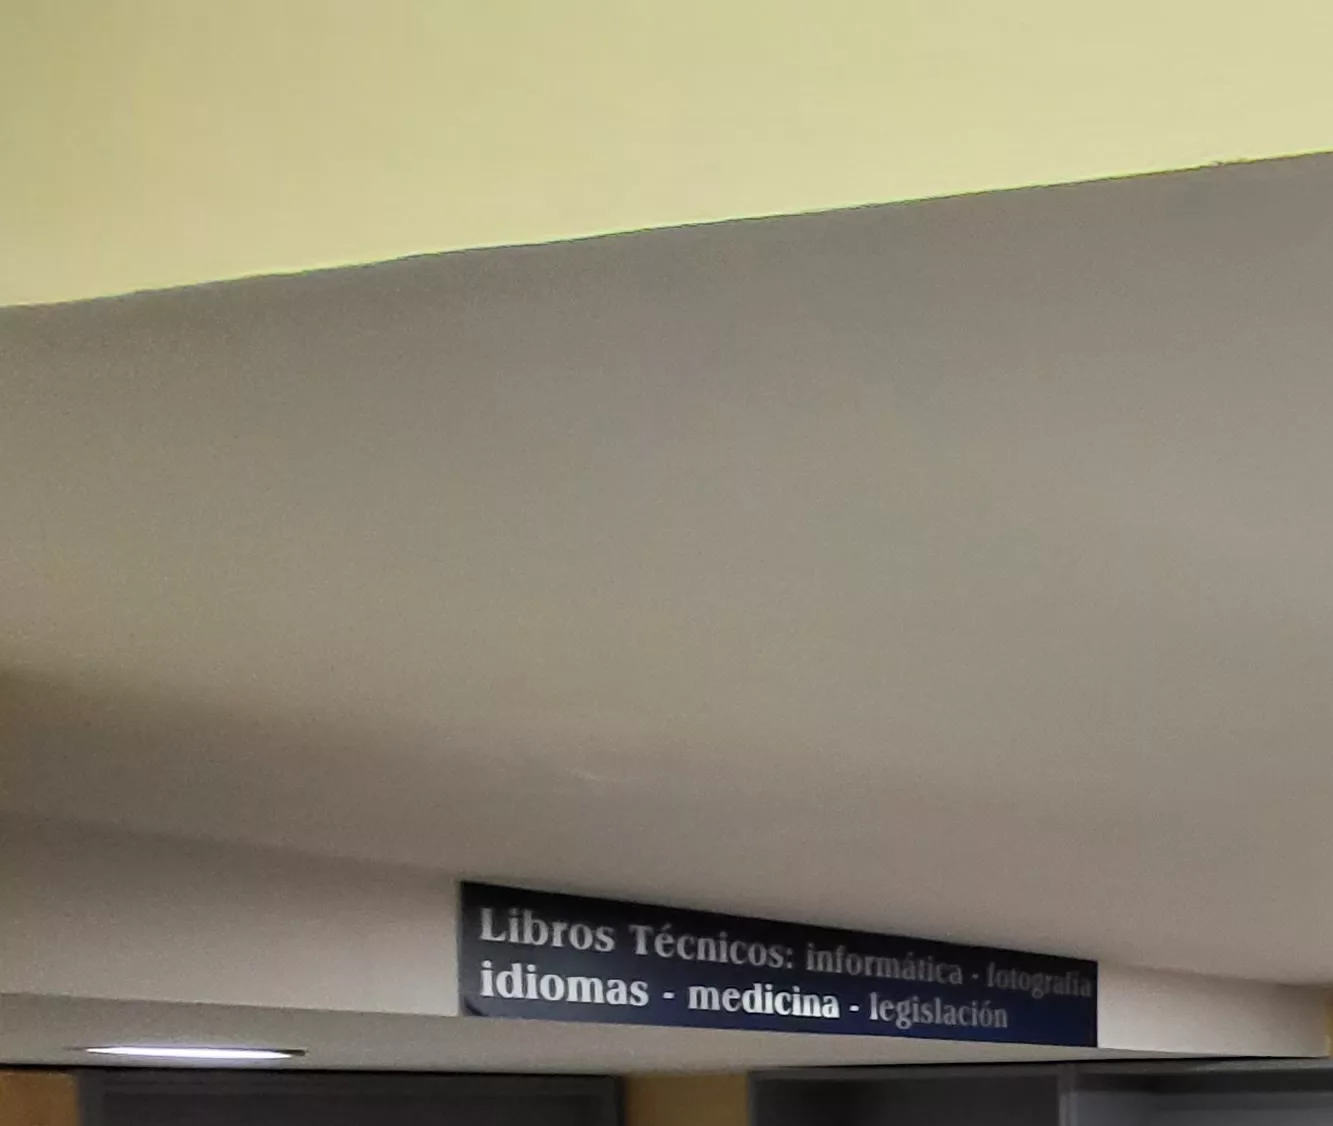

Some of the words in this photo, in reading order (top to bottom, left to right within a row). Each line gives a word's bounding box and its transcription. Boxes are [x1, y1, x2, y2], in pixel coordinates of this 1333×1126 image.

[479, 906, 615, 953] Libros
[629, 921, 793, 970] Técnicos:
[805, 941, 964, 986] informática
[987, 963, 1092, 1000] fotografía
[479, 960, 649, 1007] idiomas
[689, 984, 839, 1020] medicina
[869, 993, 1008, 1031] legislación
